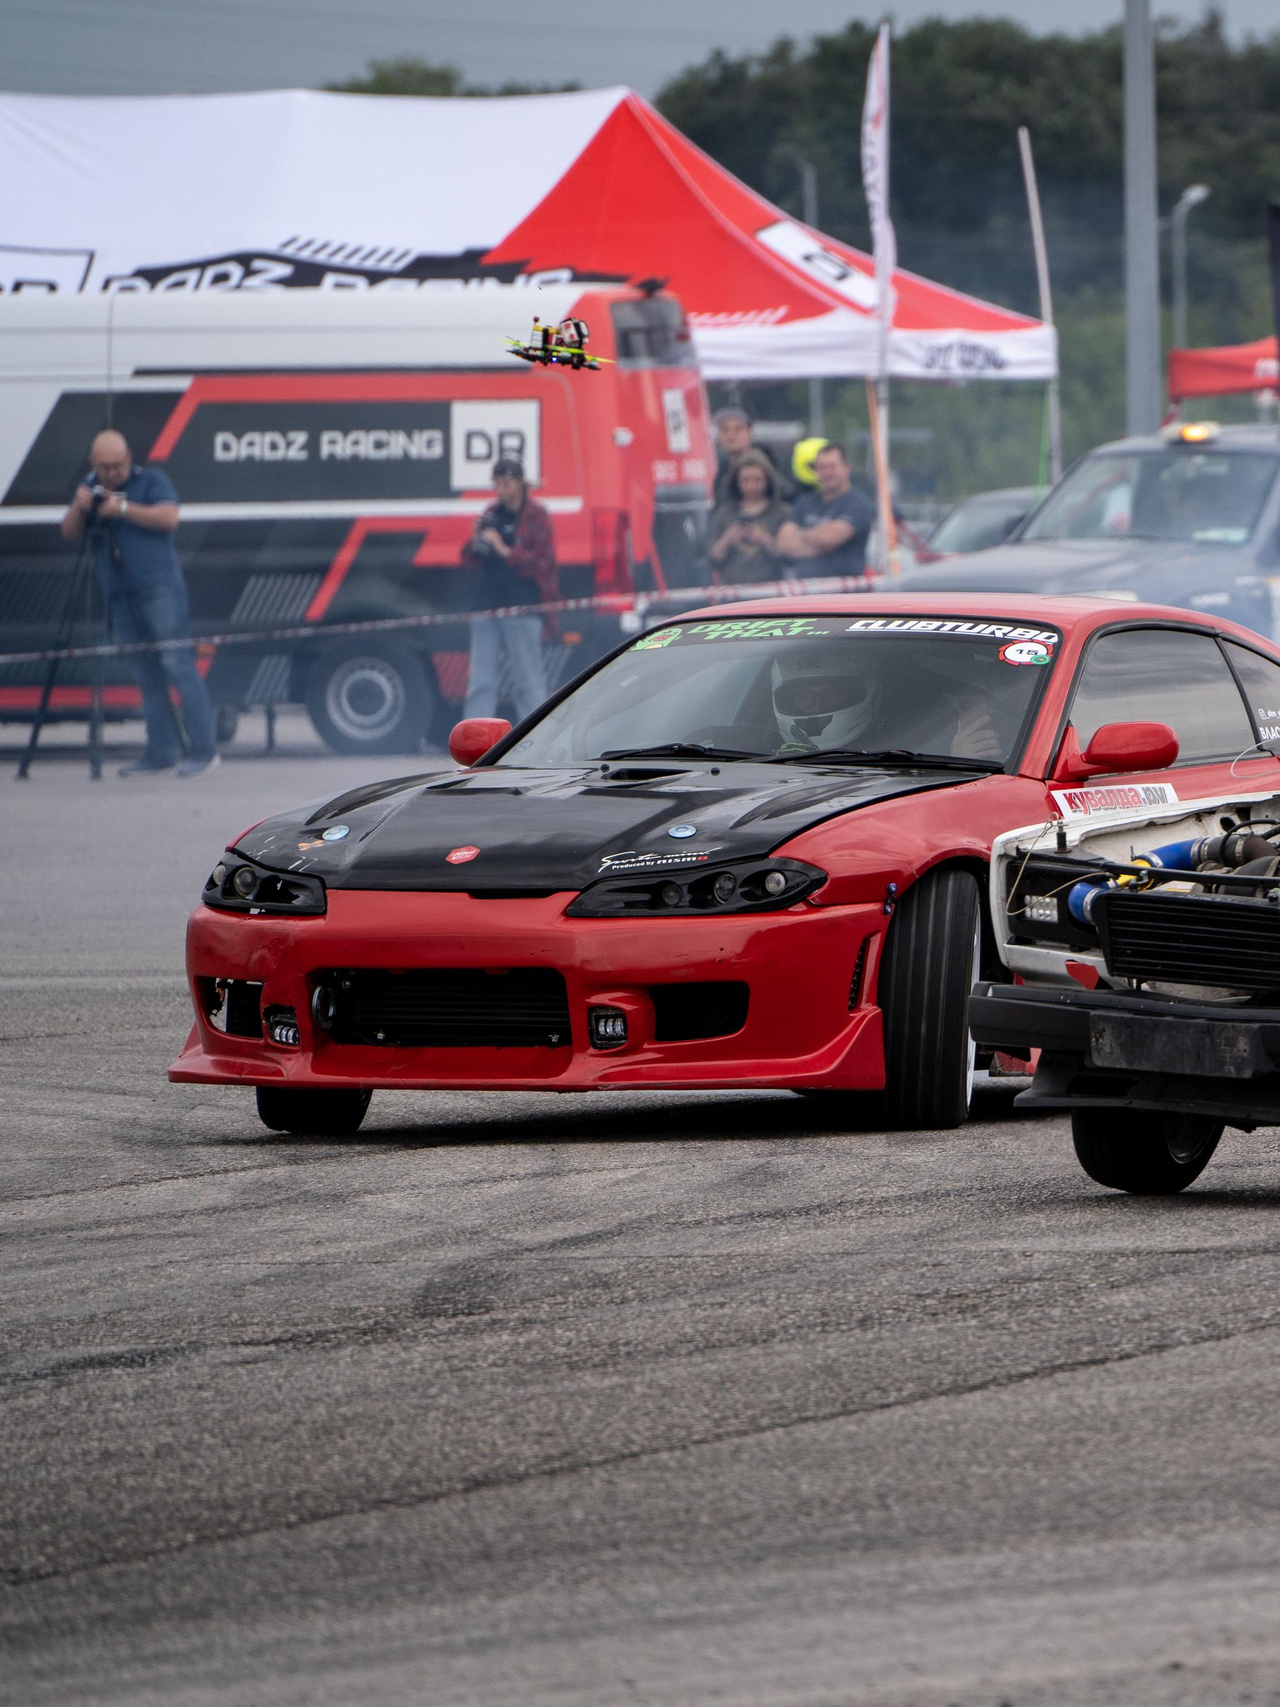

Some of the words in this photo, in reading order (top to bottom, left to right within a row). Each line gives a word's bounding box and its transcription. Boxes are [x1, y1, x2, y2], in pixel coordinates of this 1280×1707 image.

[214, 431, 309, 462] DADZ
[320, 429, 444, 460] RACING
[687, 618, 818, 634] DRIFT
[848, 619, 1059, 644] CLUBTURBO
[611, 861, 645, 870] Produced
